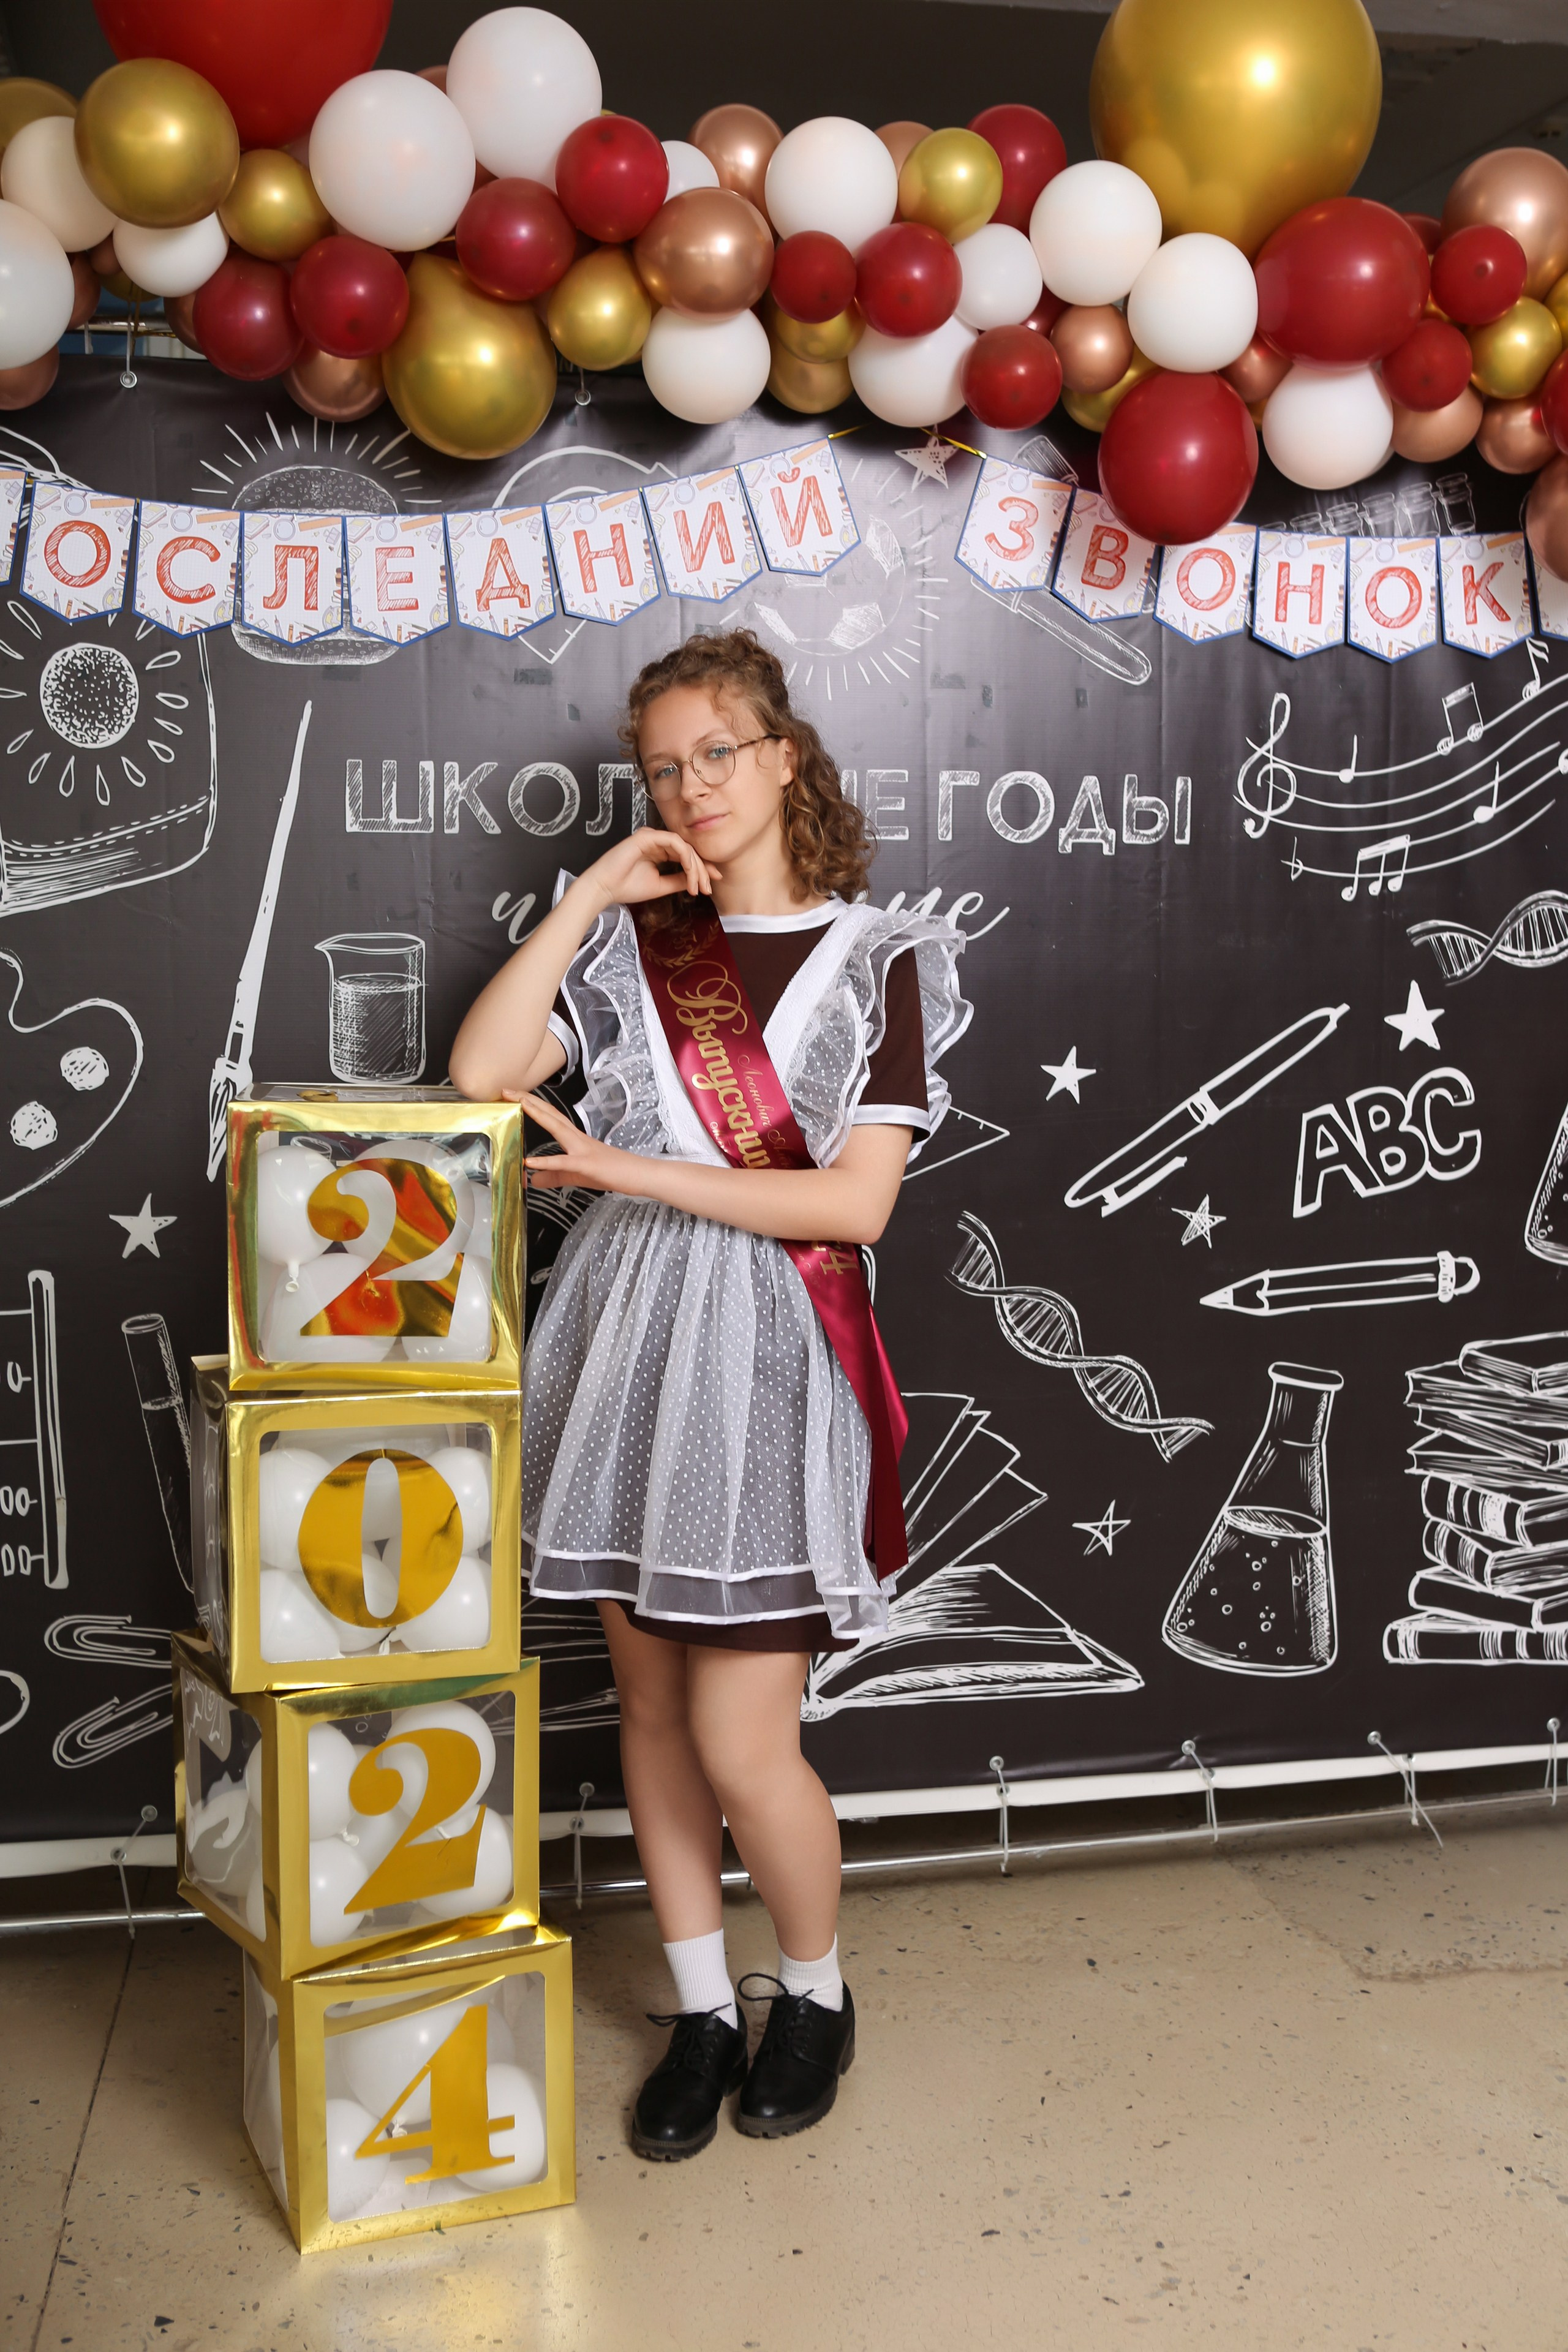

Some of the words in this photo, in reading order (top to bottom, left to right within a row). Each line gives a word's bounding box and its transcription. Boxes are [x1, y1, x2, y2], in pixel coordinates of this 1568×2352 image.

[44, 466, 832, 611] ОСЛЕДНИЙ
[984, 496, 1511, 628] ЗВОНОК
[345, 760, 910, 842] ШКОЛЕ
[938, 770, 1192, 856] ГОДЫ
[1293, 1067, 1482, 1218] ABC
